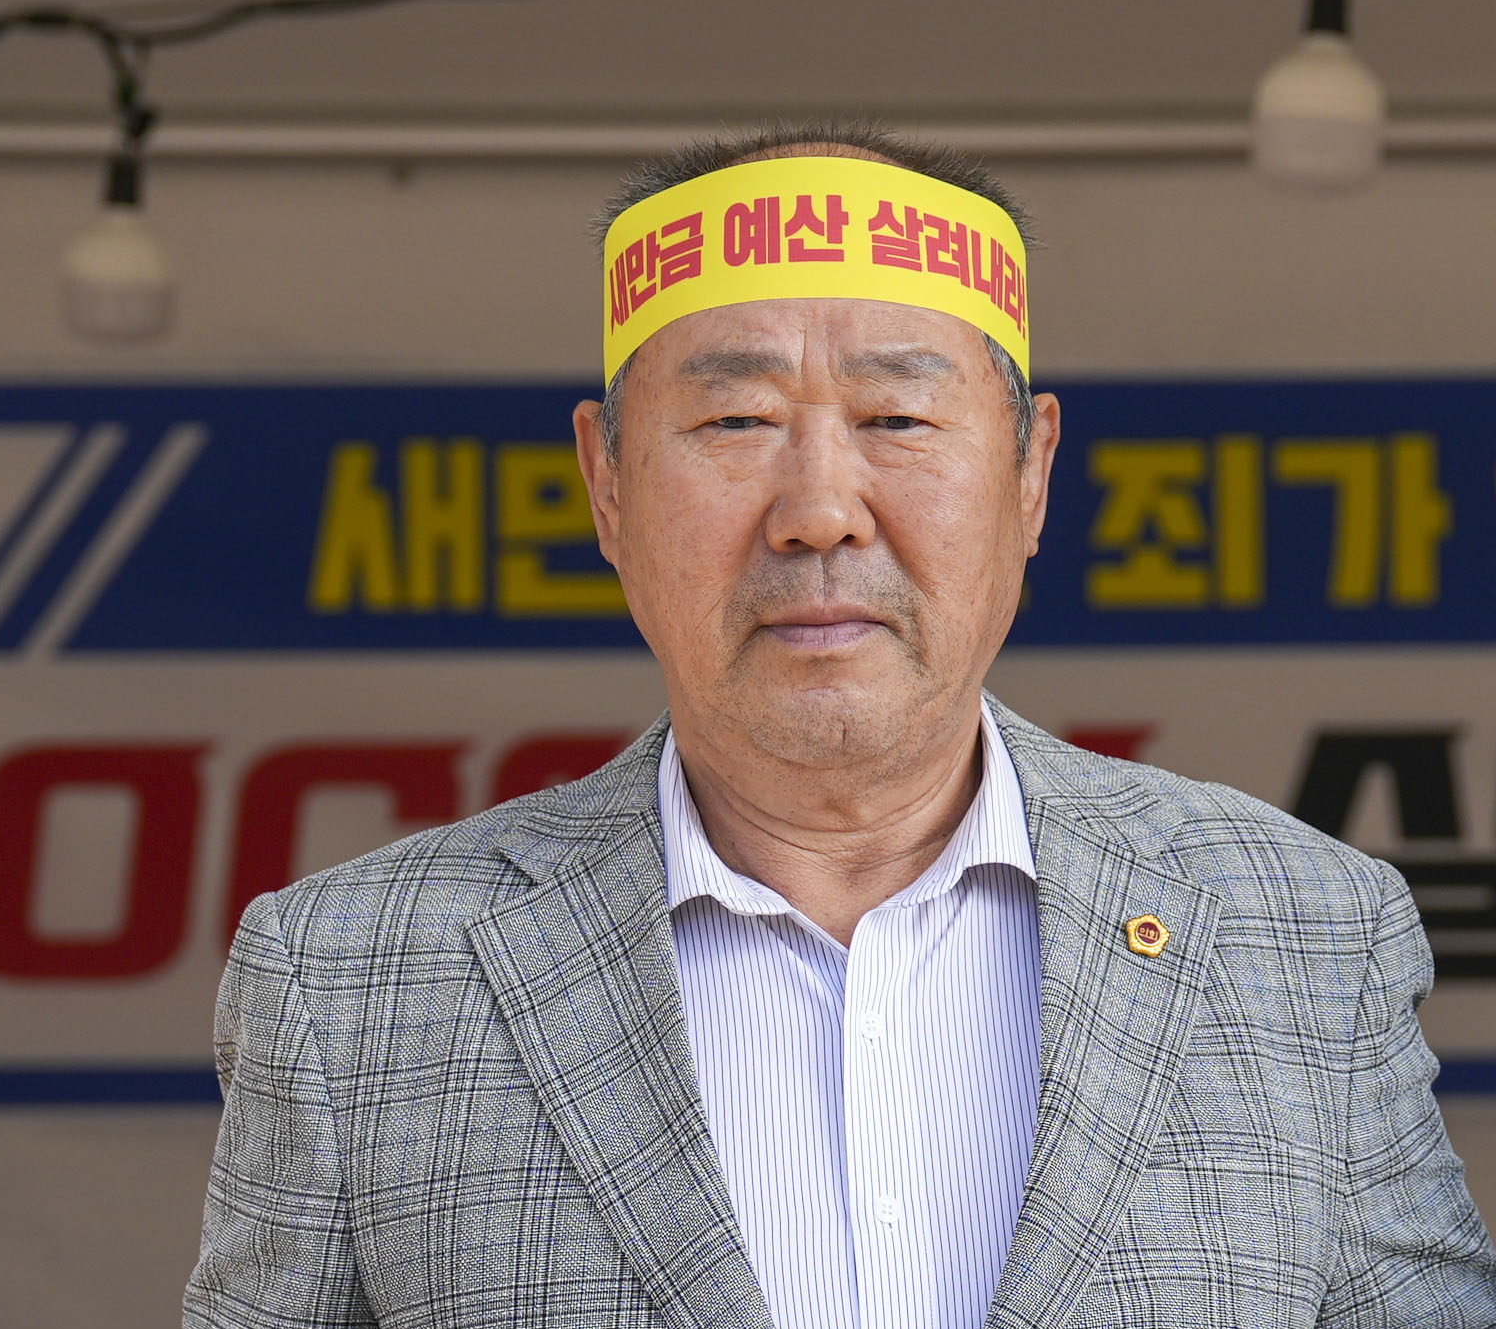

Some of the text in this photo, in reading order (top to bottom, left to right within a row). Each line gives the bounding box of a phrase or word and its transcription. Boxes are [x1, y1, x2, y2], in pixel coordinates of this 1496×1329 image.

[610, 194, 1026, 342] 새만금 예산 살려내라!
[1088, 435, 1451, 608] 죄가
